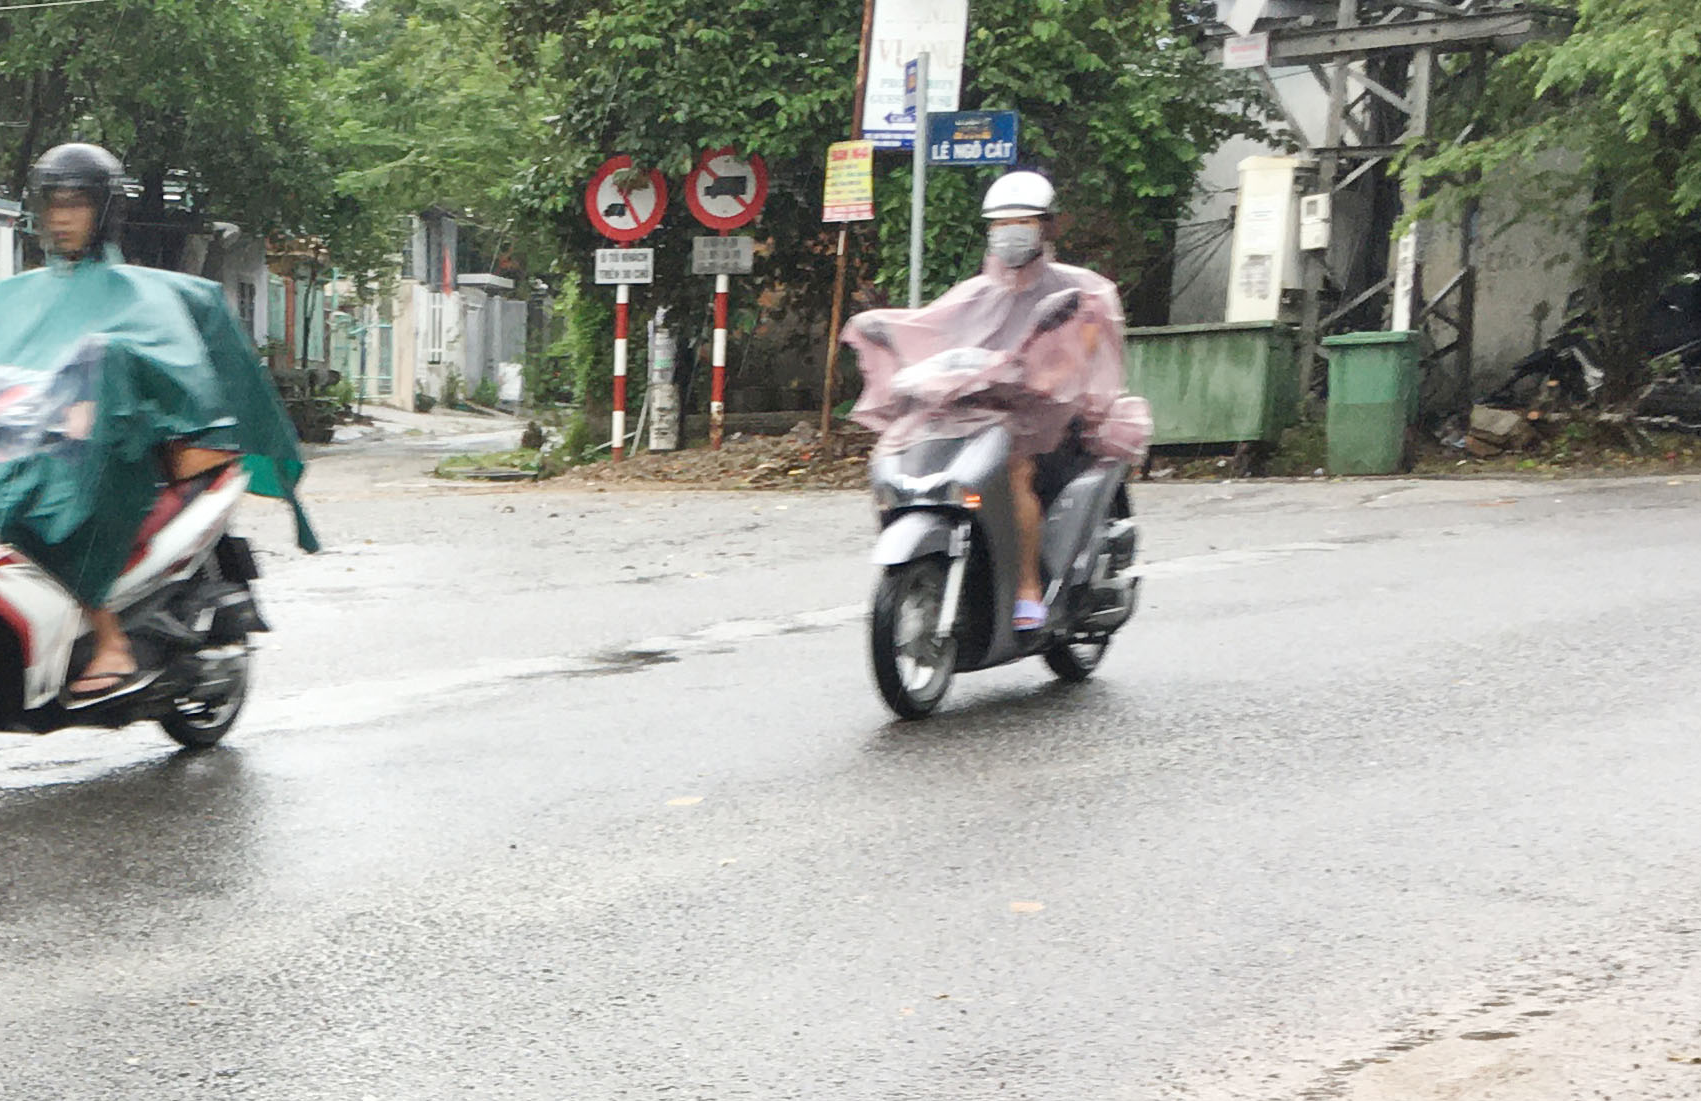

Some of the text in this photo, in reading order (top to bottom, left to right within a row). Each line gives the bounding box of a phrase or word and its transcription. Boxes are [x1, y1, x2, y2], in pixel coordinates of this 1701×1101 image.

[932, 140, 1013, 160] LÊ NGÔ CÁT
